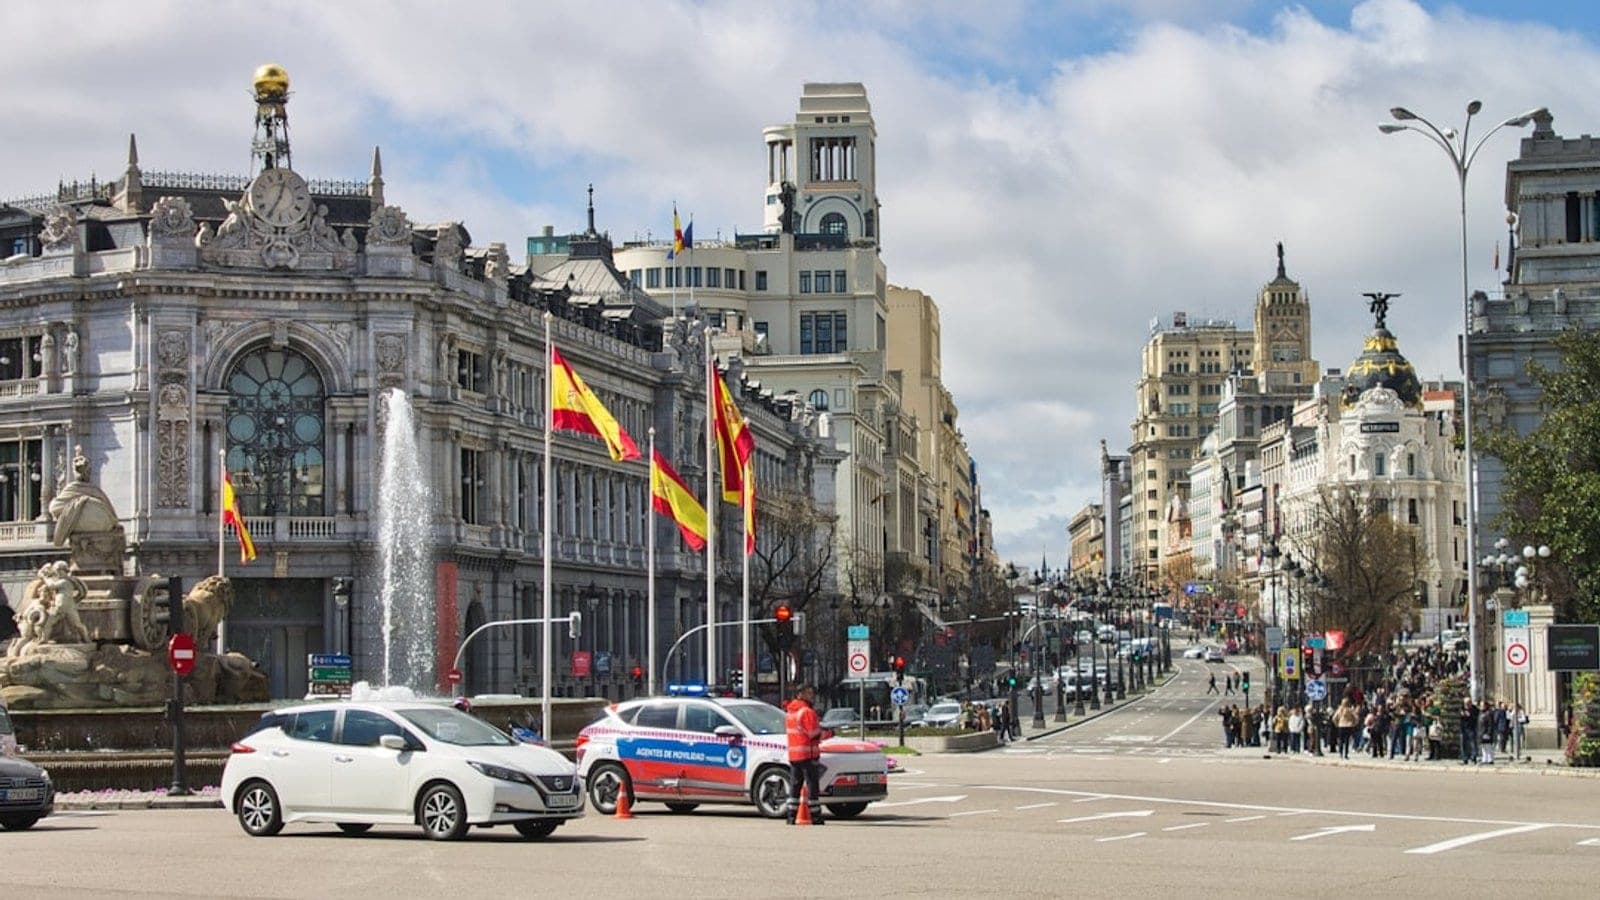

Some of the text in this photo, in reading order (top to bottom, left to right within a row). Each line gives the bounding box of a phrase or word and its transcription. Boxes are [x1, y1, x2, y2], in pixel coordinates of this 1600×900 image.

[636, 747, 663, 757] AGENTES
[664, 749, 671, 758] DE
[672, 750, 705, 760] MOVILIDAD
